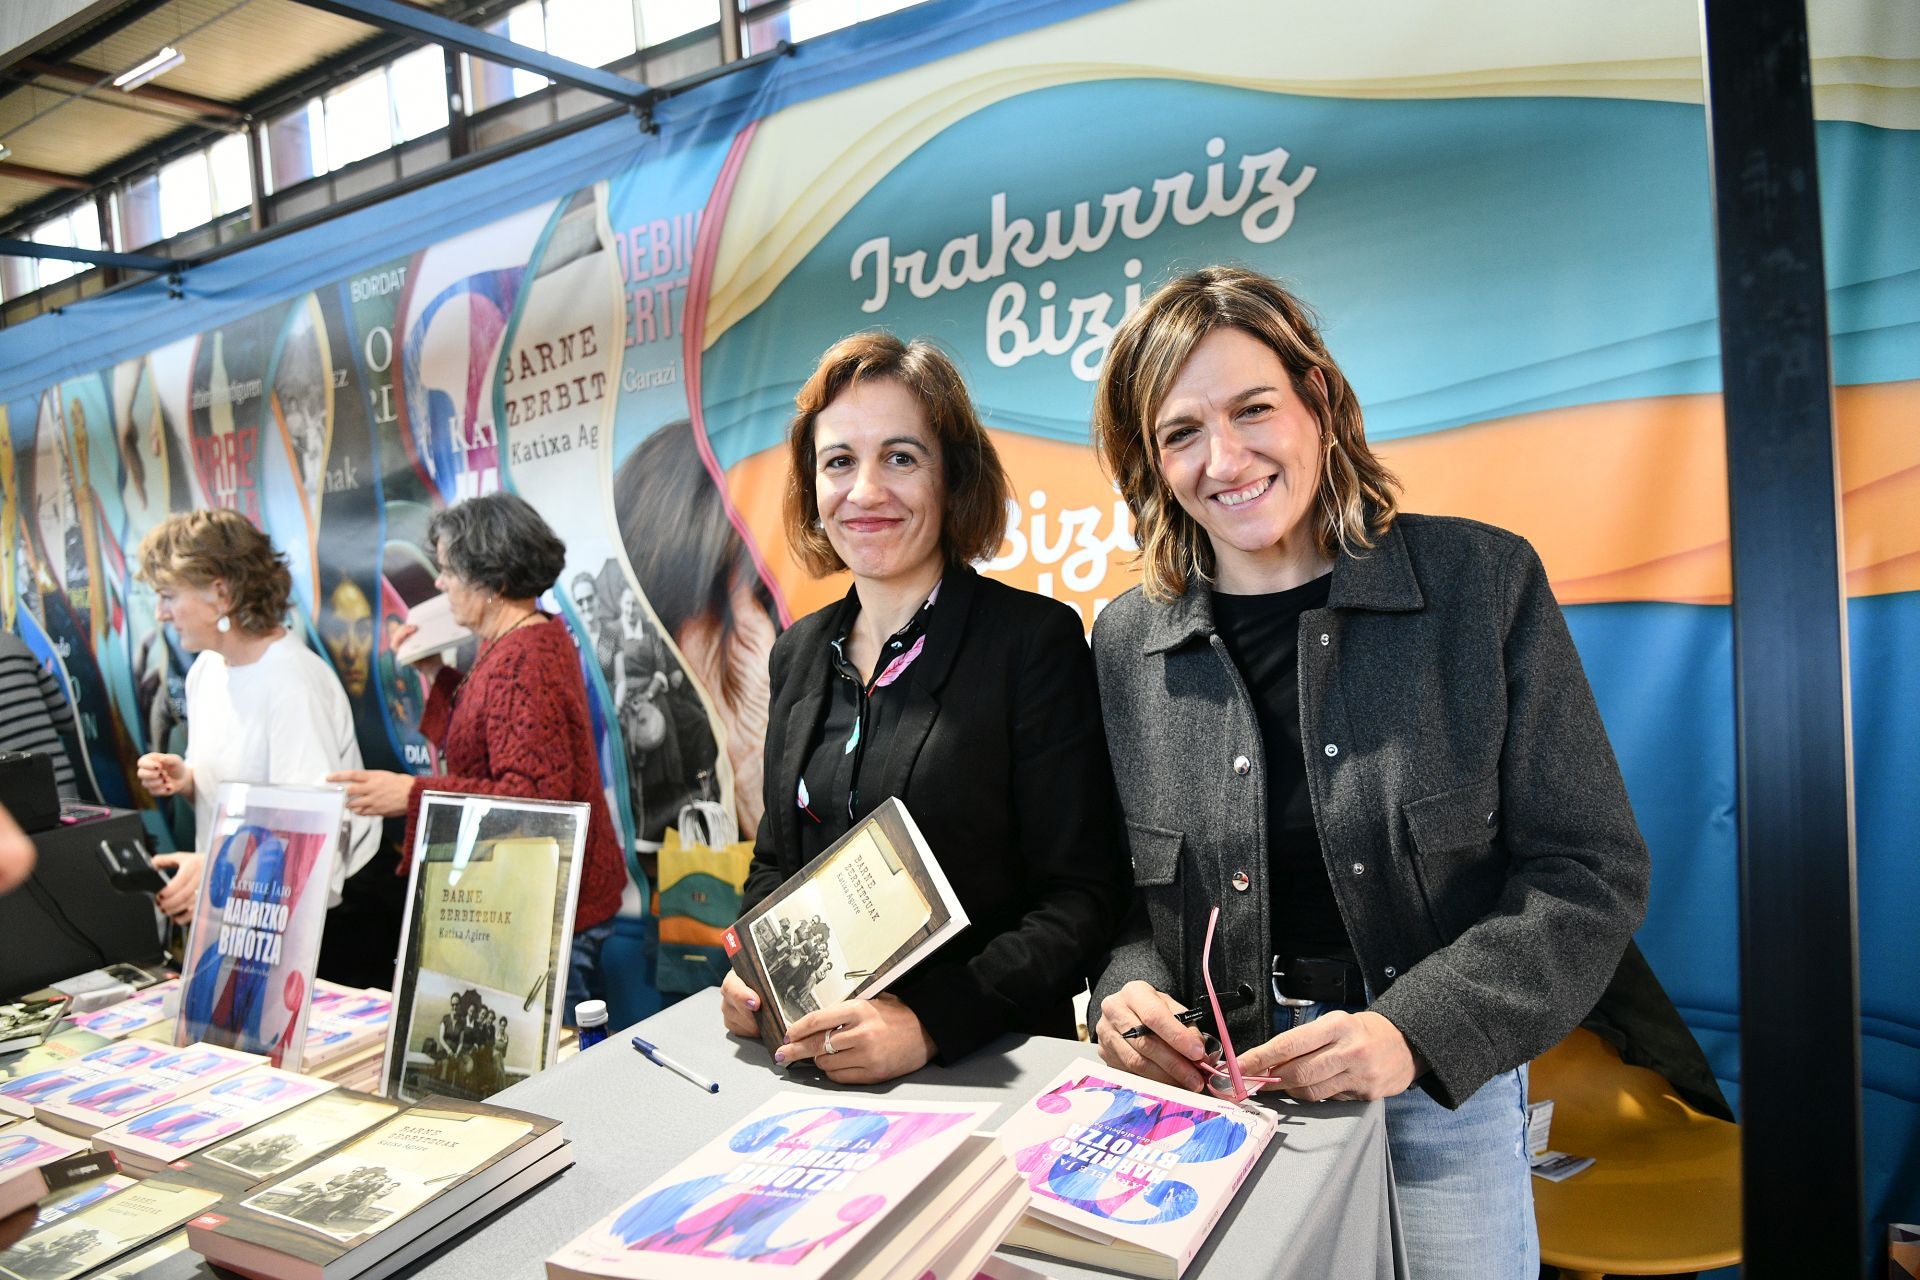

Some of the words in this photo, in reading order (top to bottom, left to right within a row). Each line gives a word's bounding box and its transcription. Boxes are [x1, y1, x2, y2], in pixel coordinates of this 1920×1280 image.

[849, 136, 1317, 313] Irakurriz
[505, 371, 606, 437] ZERBIT
[511, 433, 571, 466] Katixa
[578, 423, 599, 450] Ag
[844, 863, 880, 922] ZERBITZUAK
[854, 854, 877, 889] BARNE
[223, 896, 289, 932] HARRIZKO
[439, 908, 512, 925] ZERBITZUAK
[441, 888, 483, 903] BARNE
[217, 924, 283, 966] BIHOTZA
[1050, 1136, 1170, 1185] HARRIZKO
[1064, 1122, 1182, 1170] BIHOTZA
